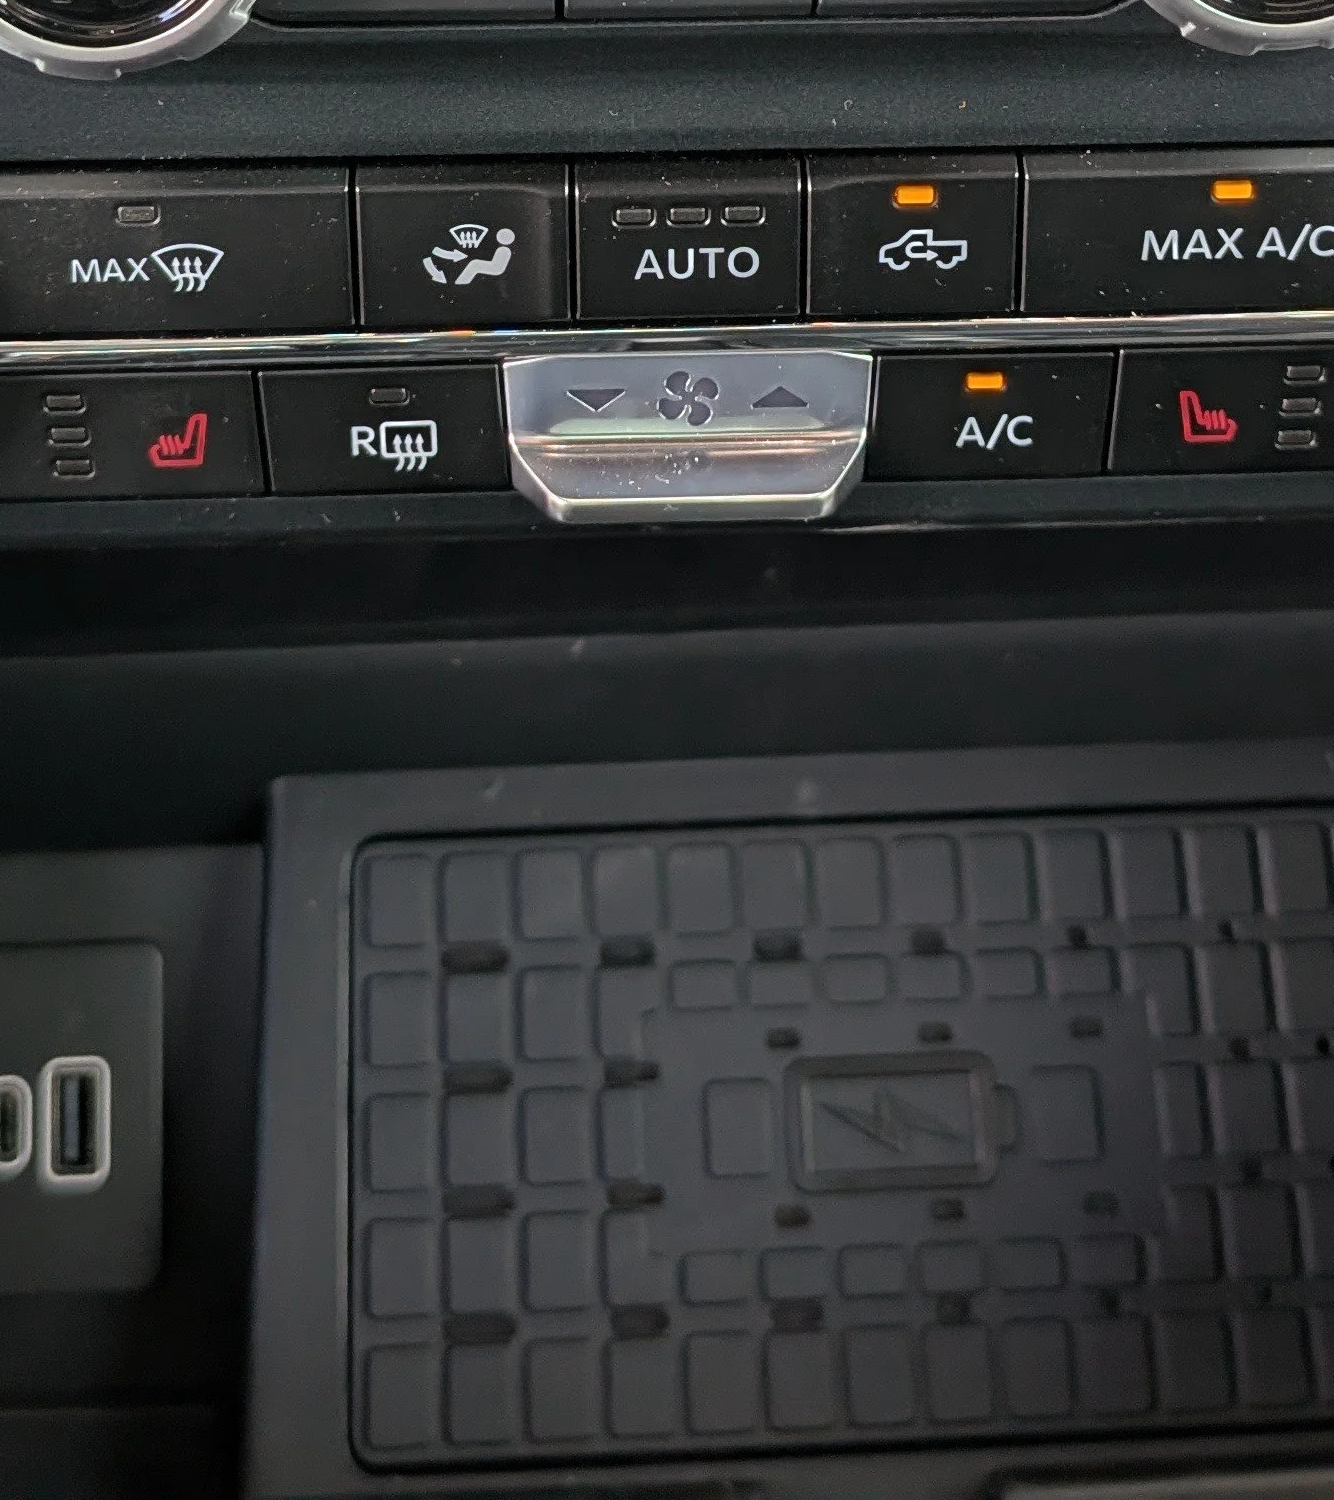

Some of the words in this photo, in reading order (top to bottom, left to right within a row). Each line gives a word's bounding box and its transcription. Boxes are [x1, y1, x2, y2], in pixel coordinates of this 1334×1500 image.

[1141, 227, 1243, 262] MAX
[71, 257, 150, 284] MAX
[634, 246, 760, 280] AUTO
[955, 413, 1034, 451] A/C
